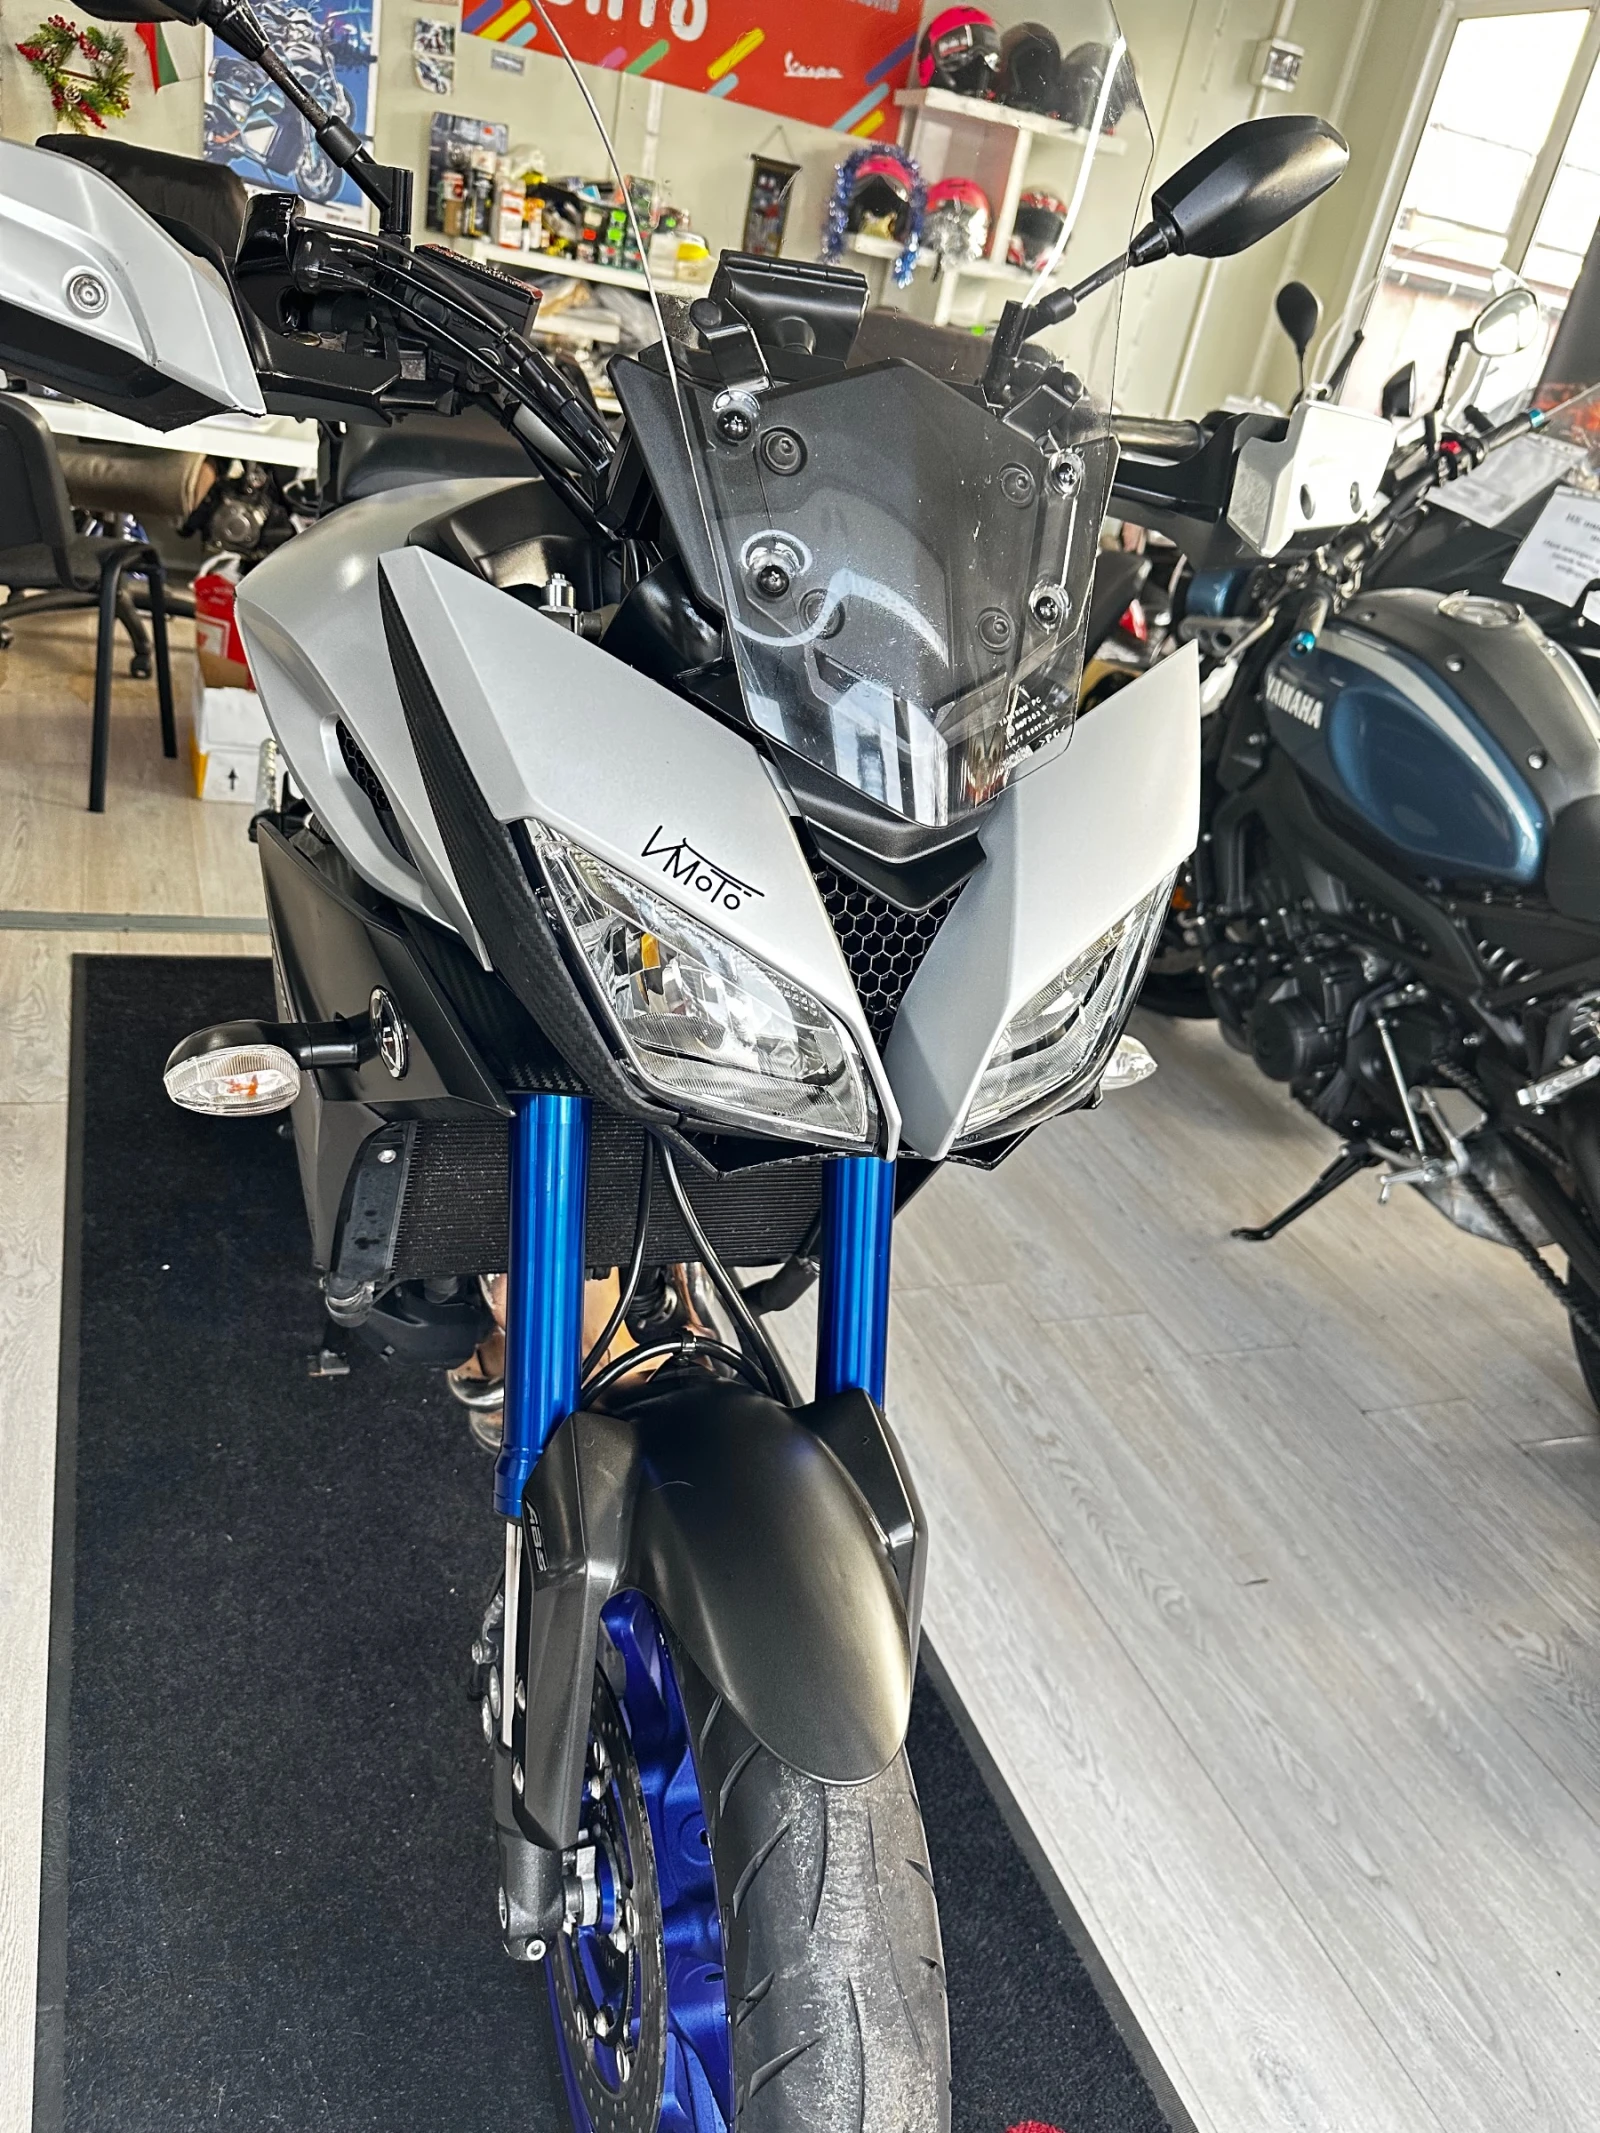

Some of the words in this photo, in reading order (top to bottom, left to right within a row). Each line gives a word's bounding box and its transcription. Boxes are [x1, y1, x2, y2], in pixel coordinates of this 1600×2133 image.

[784, 50, 844, 79] Vespa
[1265, 673, 1324, 730] YAMAHA
[525, 1500, 547, 1572] ABS
